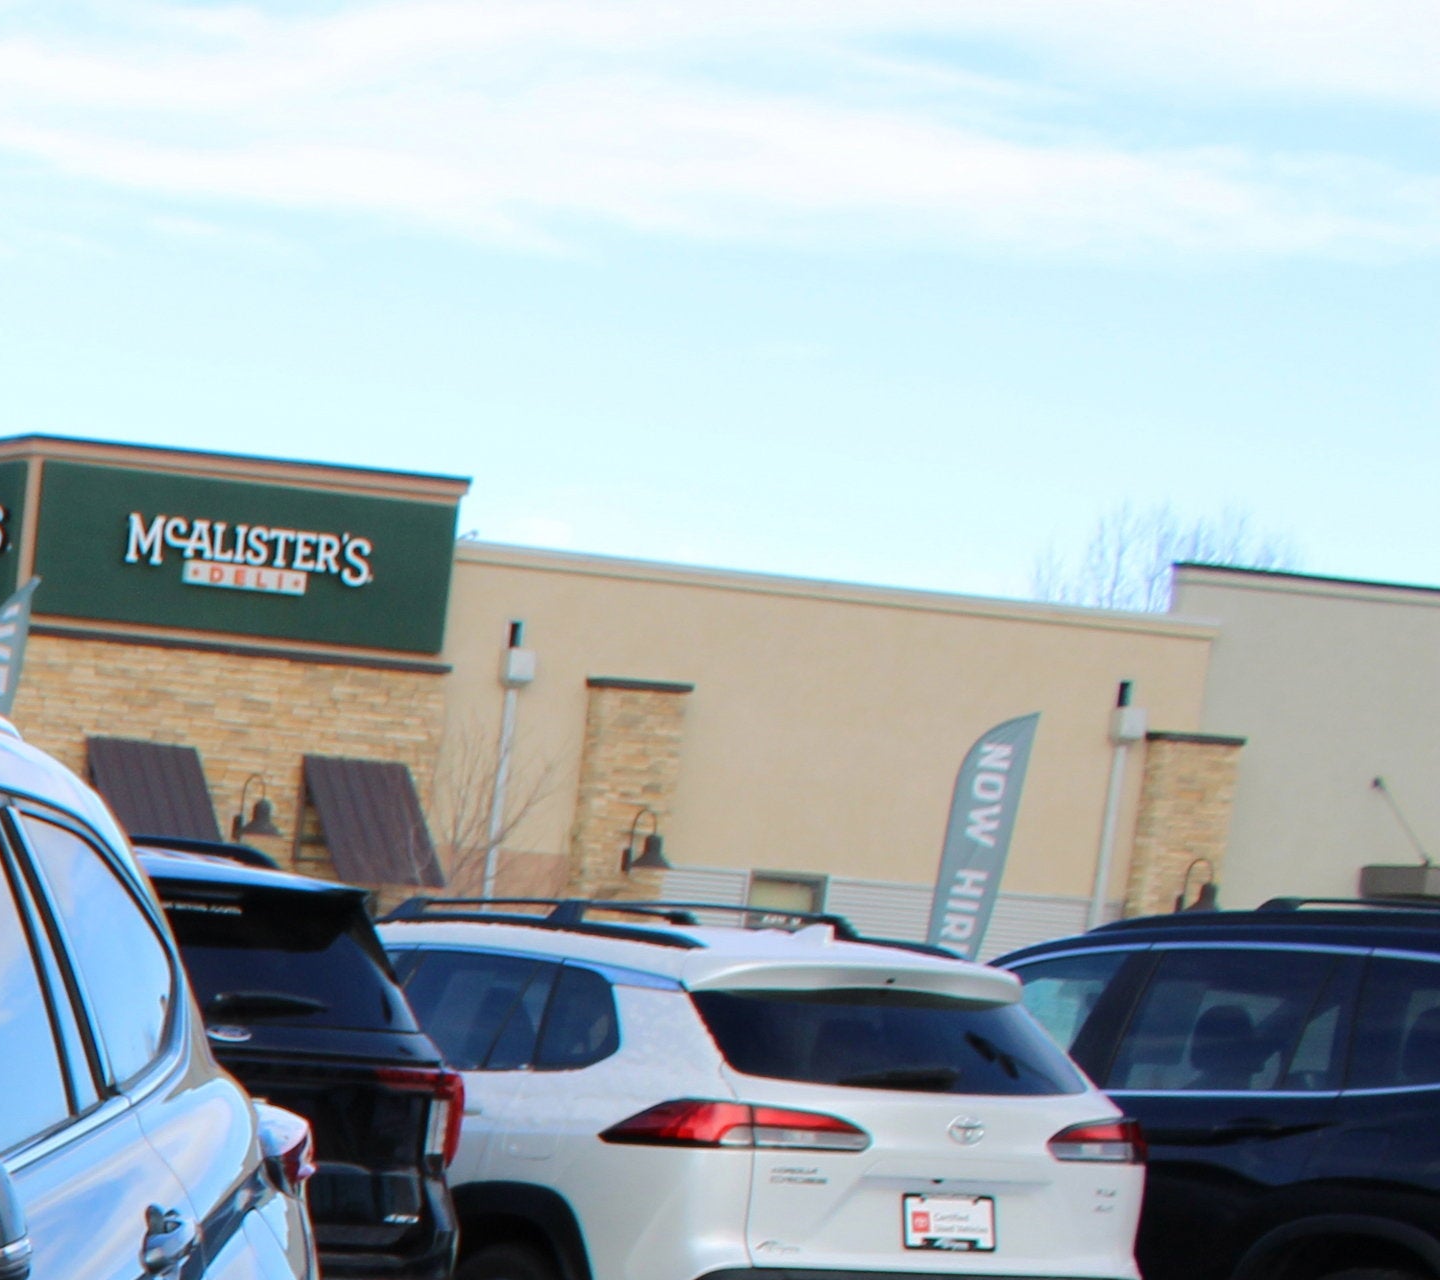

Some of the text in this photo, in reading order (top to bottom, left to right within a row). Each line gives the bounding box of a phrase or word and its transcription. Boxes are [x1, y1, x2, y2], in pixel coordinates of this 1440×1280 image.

[208, 566, 285, 590] DELI
[936, 742, 1014, 956] NOW HIRI
